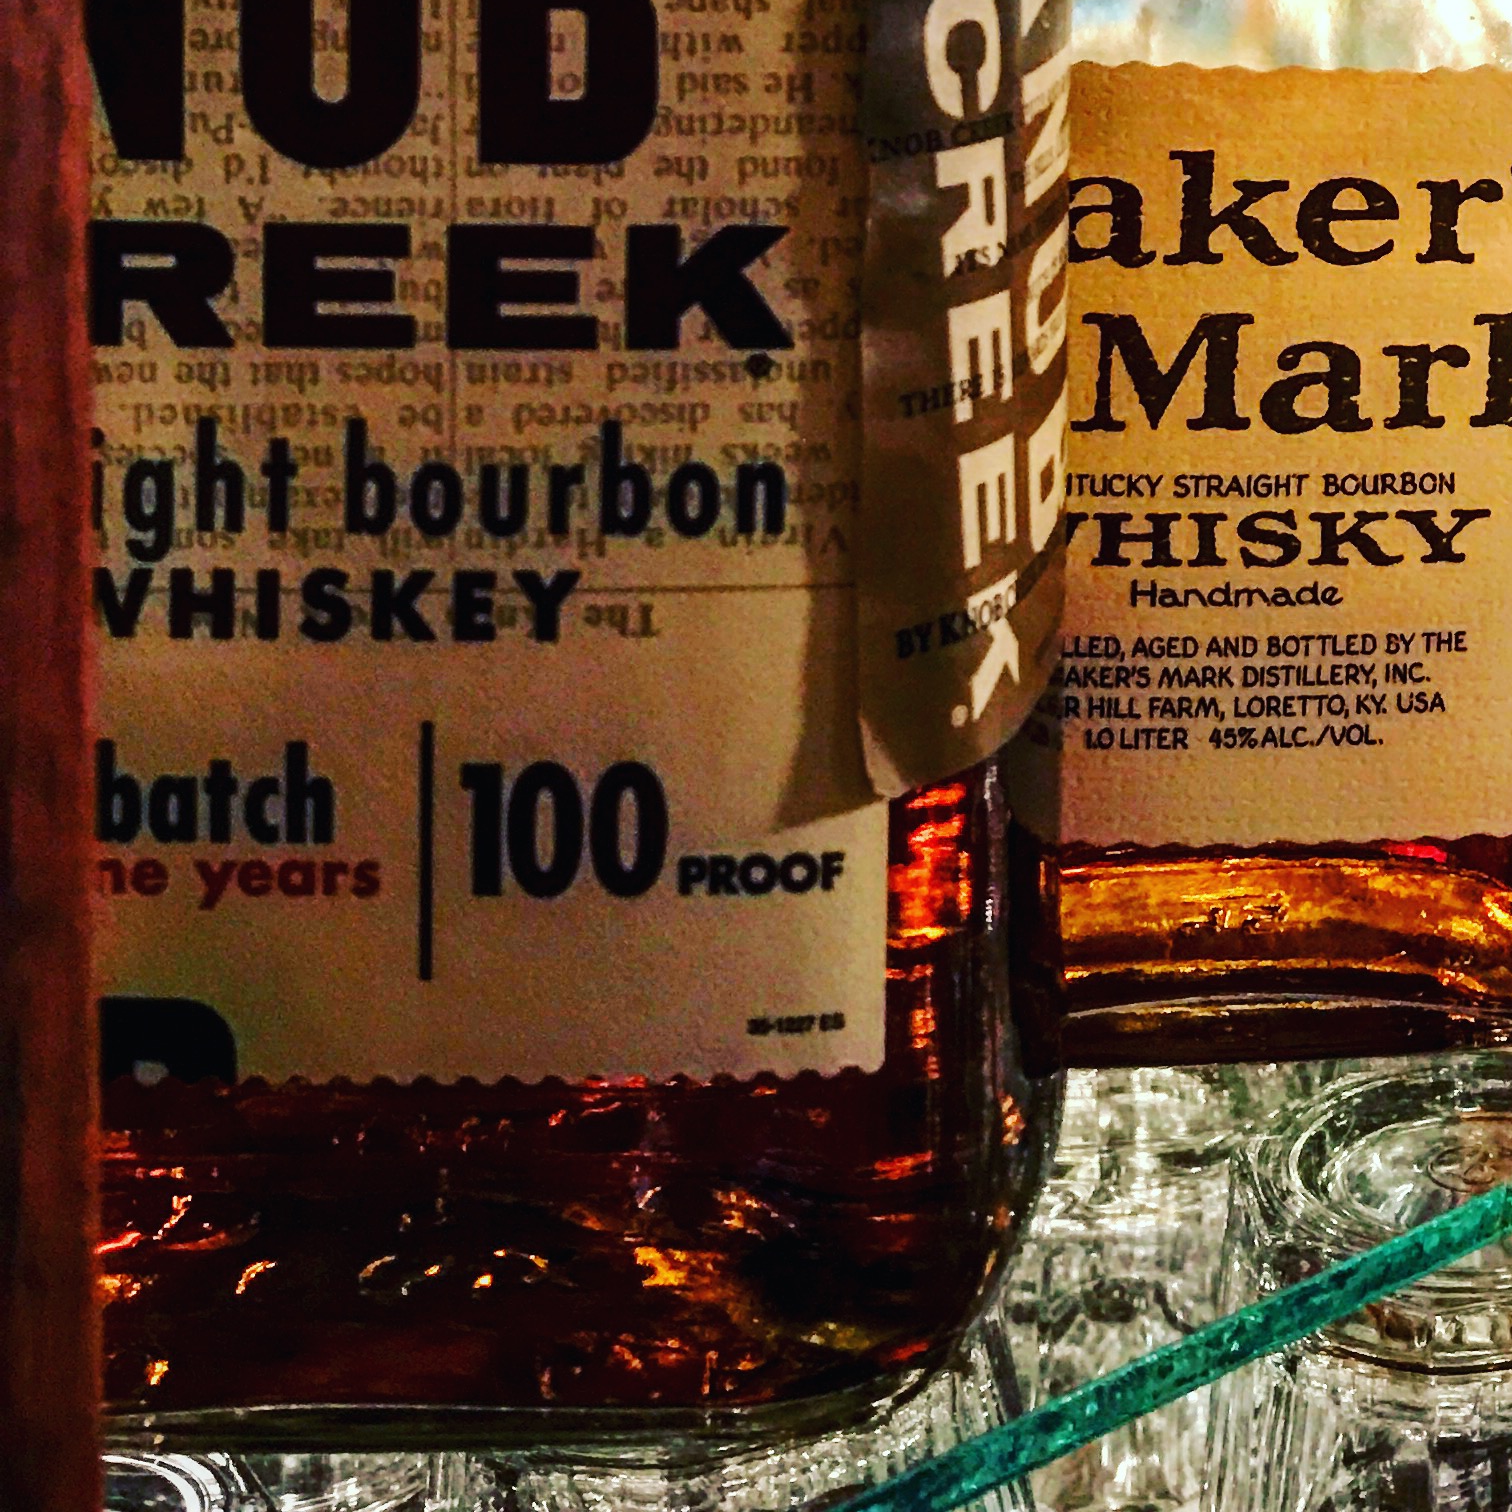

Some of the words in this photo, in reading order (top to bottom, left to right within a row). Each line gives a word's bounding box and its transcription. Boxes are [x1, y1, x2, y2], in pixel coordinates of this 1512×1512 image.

[677, 72, 750, 104] said
[175, 361, 231, 395] the
[249, 361, 320, 395] that
[336, 356, 444, 395] hopes
[738, 402, 800, 433] has
[343, 418, 789, 538] bourbon
[1173, 472, 1310, 499] STRAIGHT
[1322, 471, 1456, 497] BOURBON
[1066, 508, 1492, 569] HISKY
[1129, 579, 1345, 609] Handmade
[1131, 634, 1199, 659] AGED
[1205, 634, 1259, 658] AND
[1267, 632, 1378, 658] BOTTLED
[1384, 632, 1412, 656] BY
[1421, 630, 1468, 654] THE
[1158, 664, 1235, 689] MARK
[1241, 663, 1378, 689] DISTILLERY,
[1384, 662, 1432, 685] INC.
[1087, 697, 1142, 720] HILL
[1148, 695, 1226, 722] FARM,
[1233, 693, 1350, 721] LORETTO,
[1355, 693, 1388, 717] KY.
[1396, 691, 1446, 715] USA
[1119, 727, 1189, 751] LITER
[97, 740, 335, 847] batch
[458, 761, 669, 899] 100
[676, 850, 846, 898] PROOF
[192, 857, 382, 911] years
